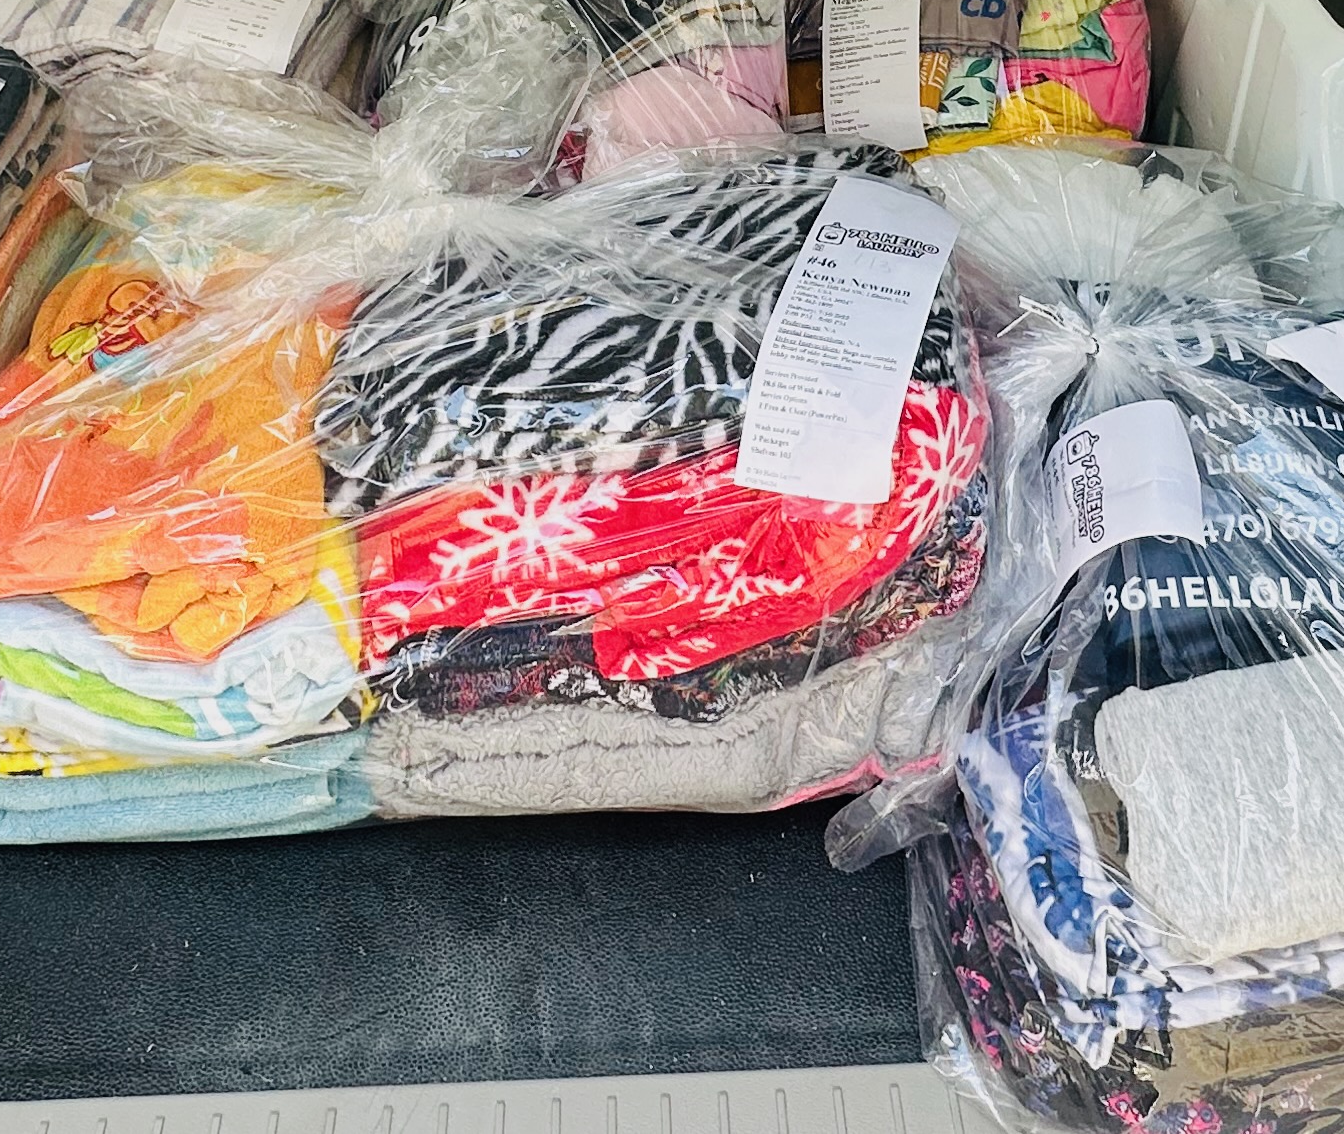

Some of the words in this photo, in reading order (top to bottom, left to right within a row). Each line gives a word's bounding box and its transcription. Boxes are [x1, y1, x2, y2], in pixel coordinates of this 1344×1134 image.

[848, 228, 881, 241] 786
[881, 233, 939, 254] HELLO
[857, 239, 925, 258] LAUNDRY
[807, 256, 837, 268] #46
[801, 269, 845, 284] Kenya
[852, 278, 911, 297] Newman
[1231, 403, 1316, 428] TRAIL
[1081, 454, 1101, 489] 786
[1086, 486, 1105, 544] HELLO
